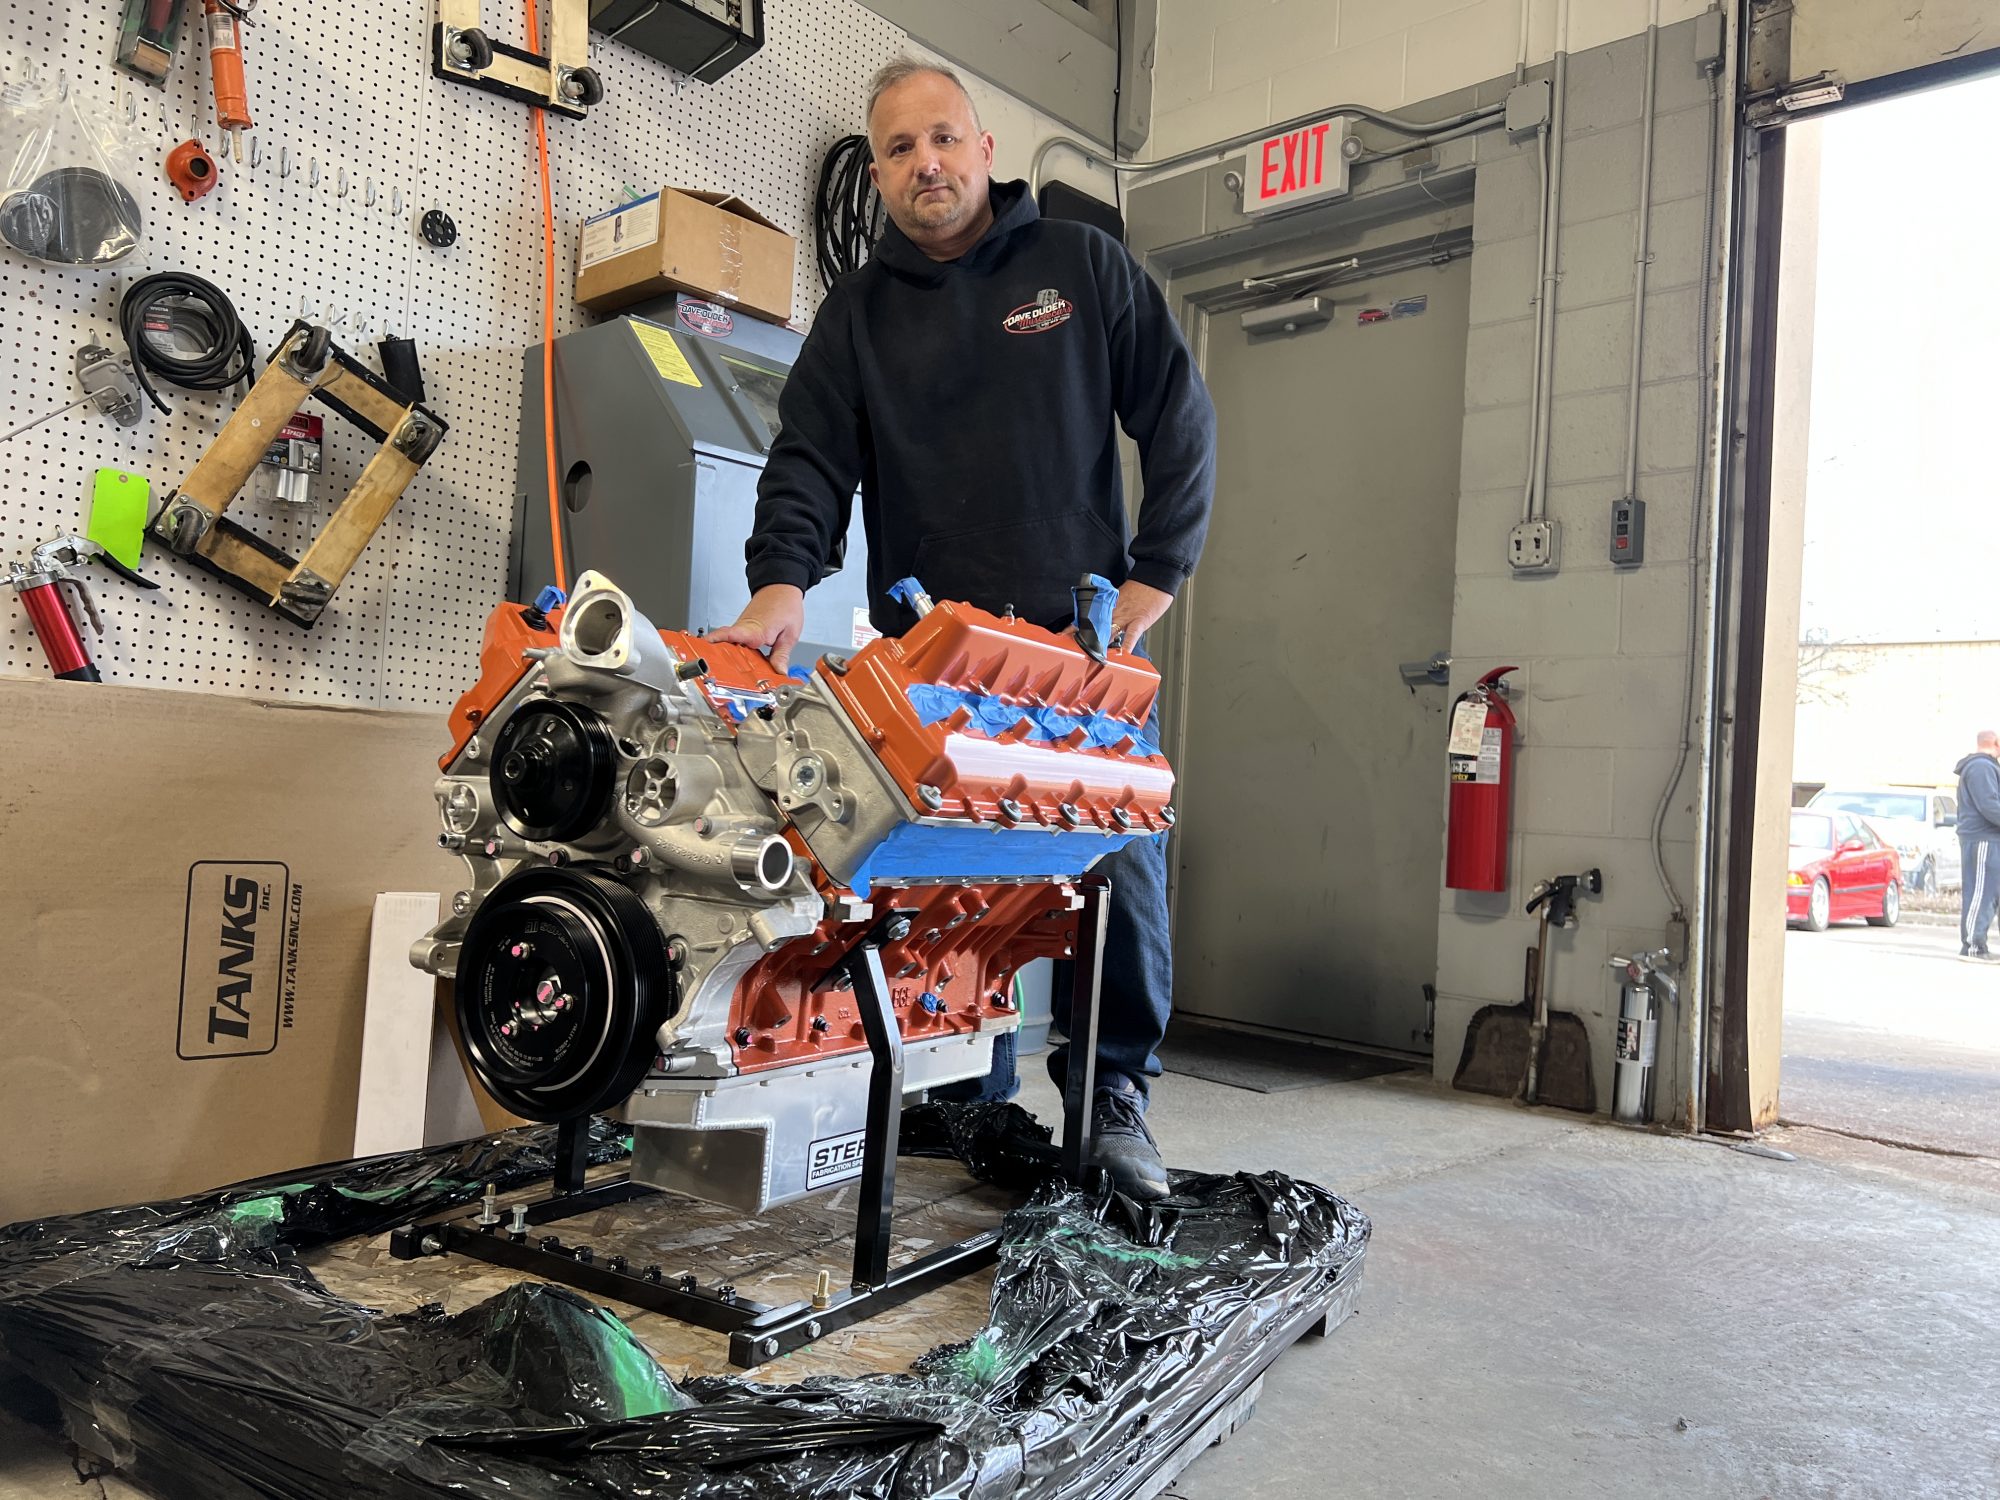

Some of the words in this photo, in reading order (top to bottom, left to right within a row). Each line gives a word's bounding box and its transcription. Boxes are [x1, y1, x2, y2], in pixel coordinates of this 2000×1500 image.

[1260, 123, 1330, 199] EXIT
[678, 303, 704, 318] DAVE
[701, 309, 731, 325] DUDEK
[1003, 312, 1032, 327] DAVE
[1032, 300, 1066, 317] DUDEK
[259, 883, 272, 912] inc.
[207, 874, 259, 1044] TANKS
[283, 883, 303, 1029] WWW.TANKSINC.COM
[812, 1162, 851, 1179] FABRICATION
